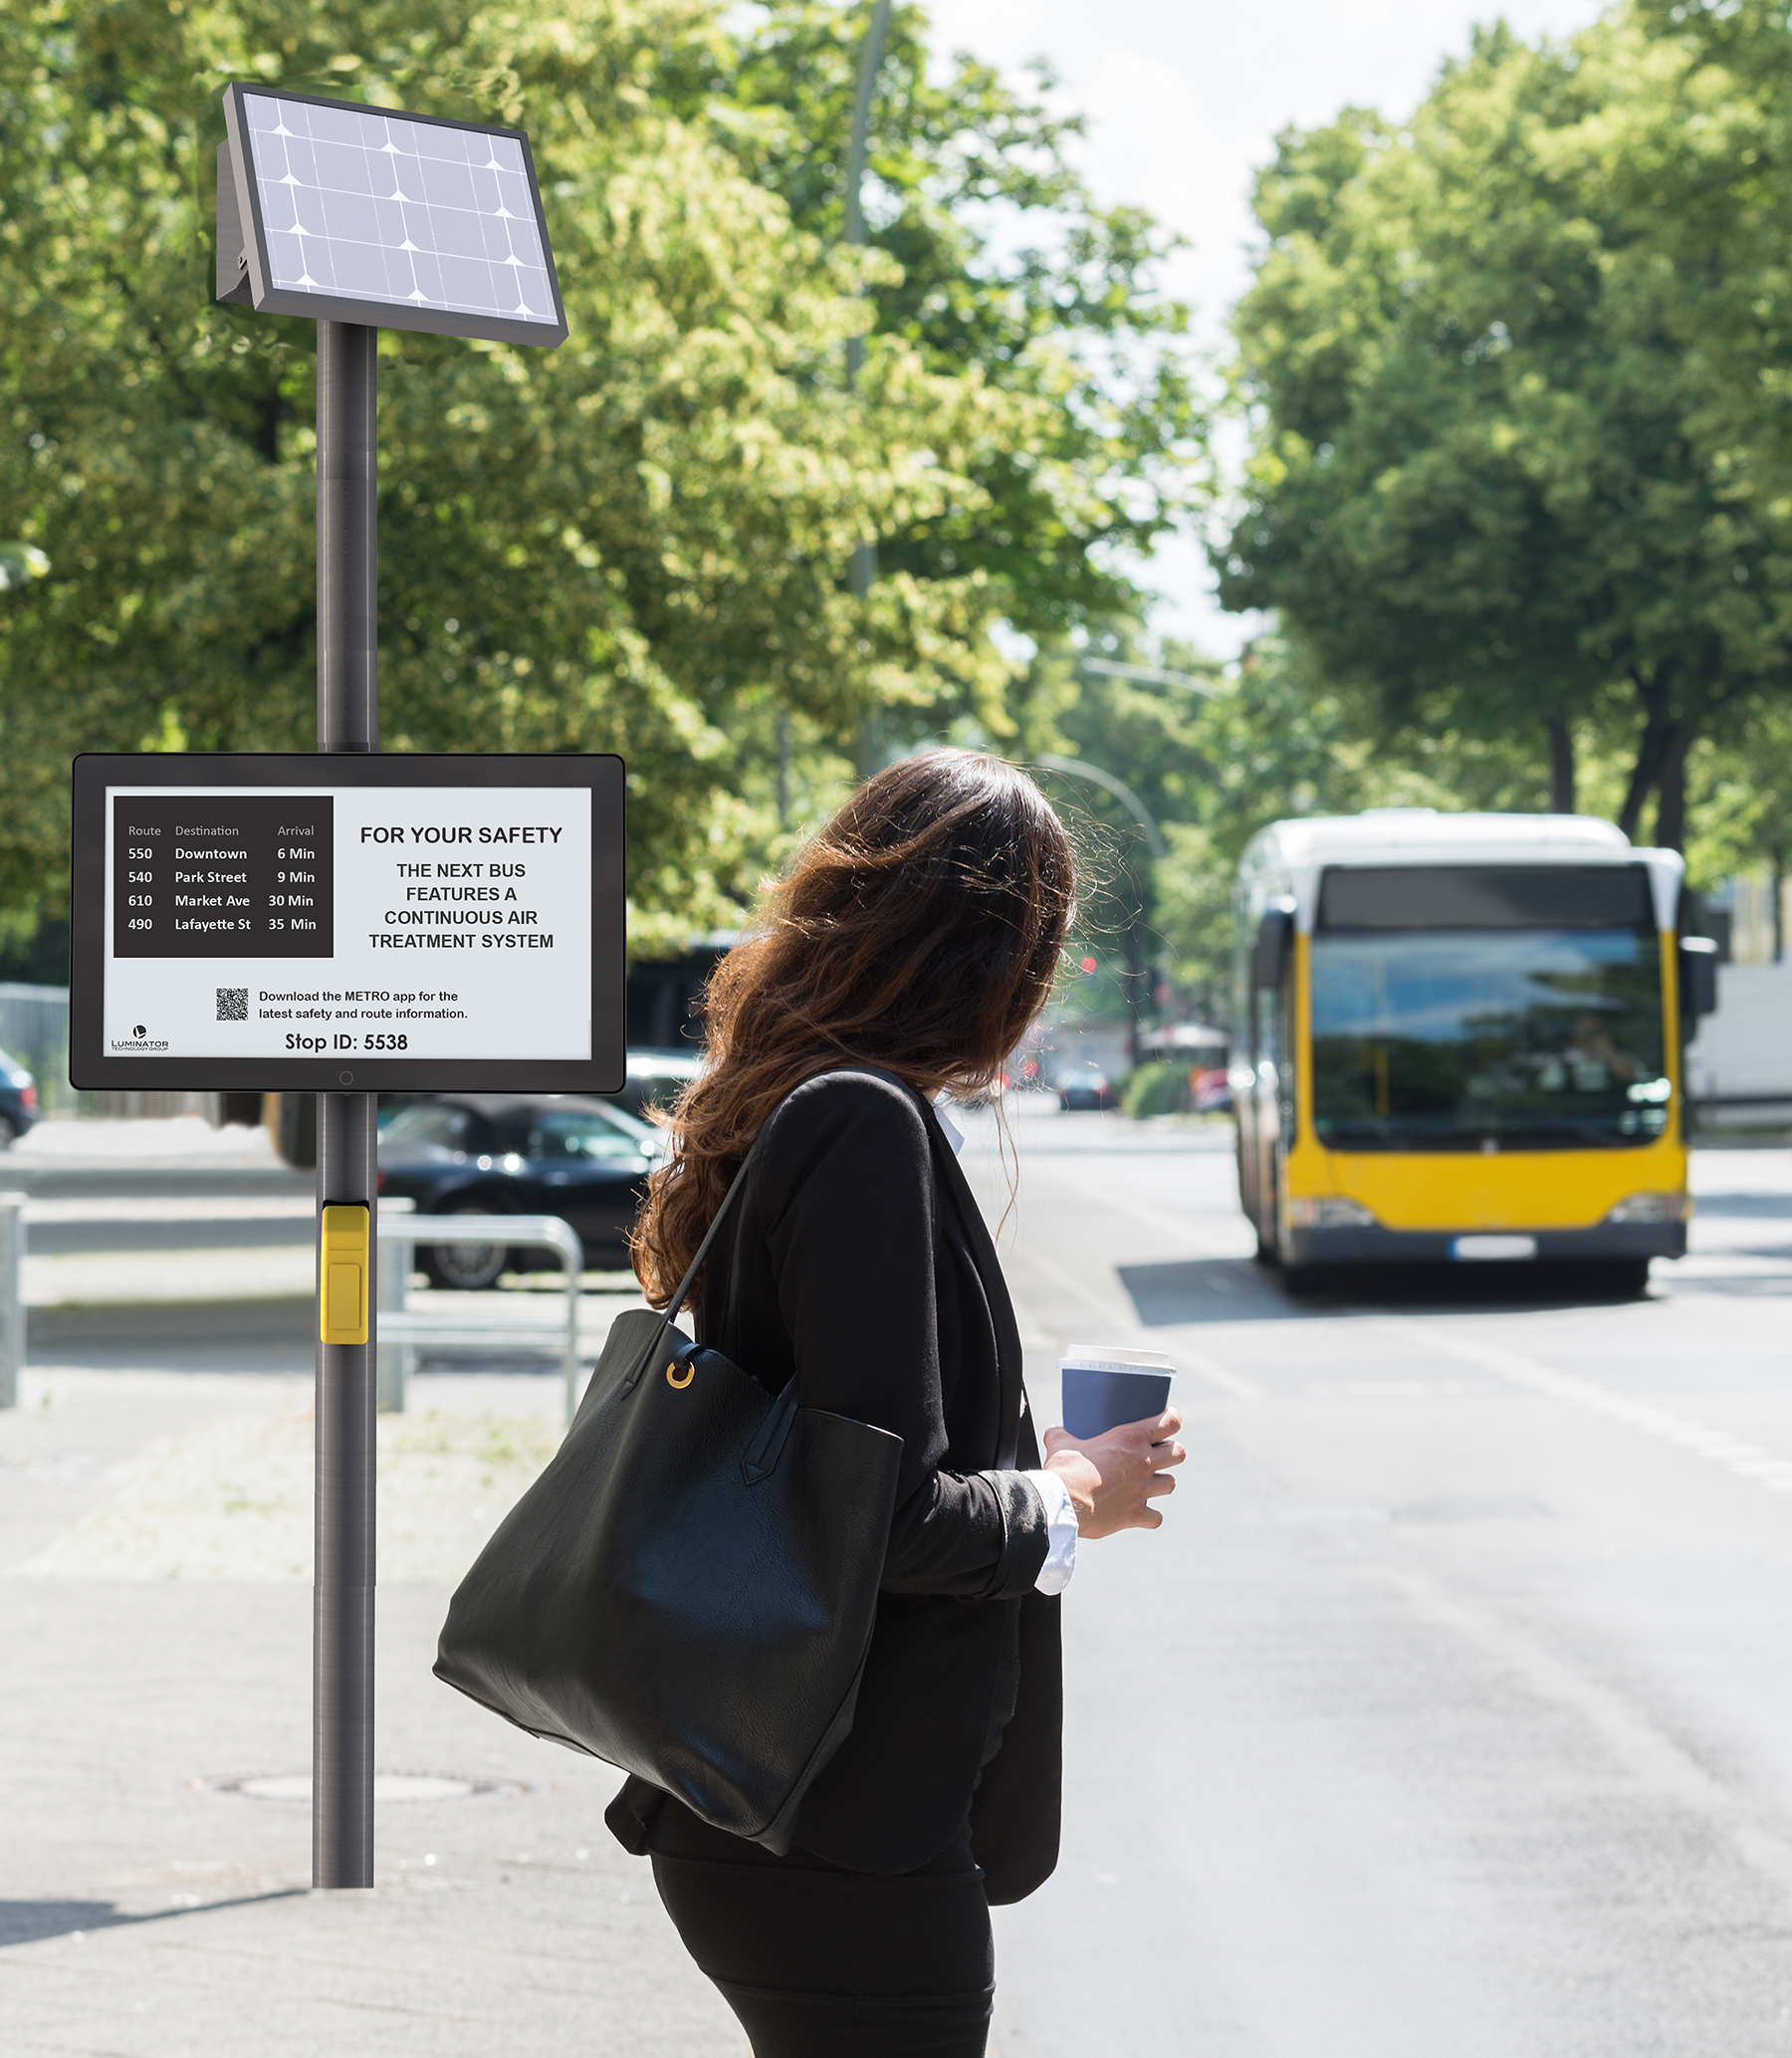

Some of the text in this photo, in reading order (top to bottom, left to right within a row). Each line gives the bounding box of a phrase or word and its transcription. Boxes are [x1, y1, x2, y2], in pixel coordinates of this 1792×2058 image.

[129, 824, 315, 836] Route Destination Arrival
[360, 826, 563, 843] FOR YOUR SAFETY
[127, 847, 316, 859] 550 Downtown 6 Min
[127, 871, 316, 883] 540 Park Street 9 Min
[396, 863, 527, 878] THE NEXT BUS
[127, 894, 314, 907] 610 Market Ave 30 Min
[406, 886, 518, 901] FEATURES A
[384, 910, 539, 925] CONTINUOUS AIR
[127, 918, 317, 933] 490 Lafayette St 35 Min
[368, 934, 554, 949] TREATMENT SYSTEM
[259, 991, 459, 1005] Download the METRO app for the
[259, 1009, 468, 1022] latest safety and route information.
[285, 1032, 408, 1053] Stop ID: 5538
